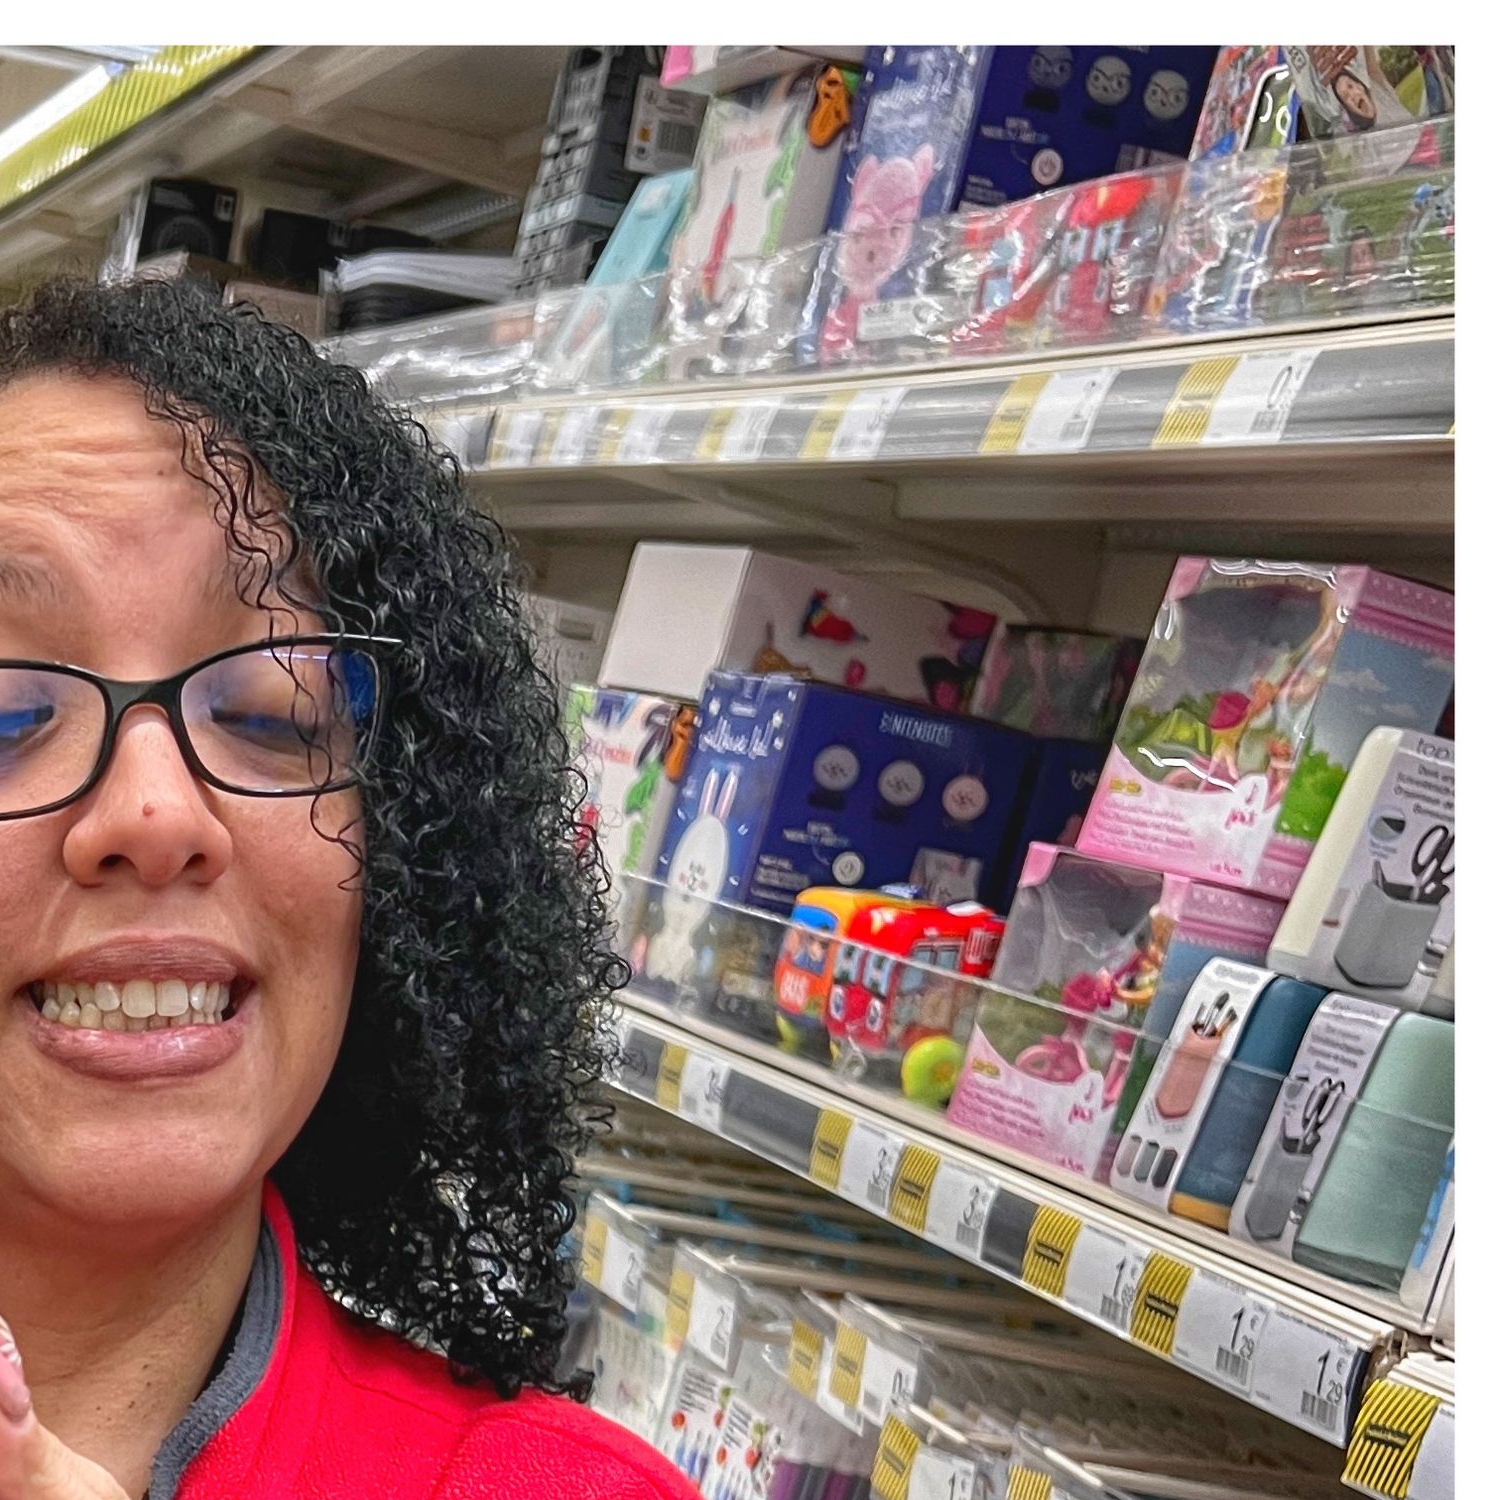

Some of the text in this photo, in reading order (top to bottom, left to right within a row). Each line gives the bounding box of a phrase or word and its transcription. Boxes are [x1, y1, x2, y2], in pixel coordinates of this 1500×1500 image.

[1233, 1306, 1245, 1350] 1
[1317, 1349, 1330, 1396] 1
[1326, 1379, 1343, 1406] 29
